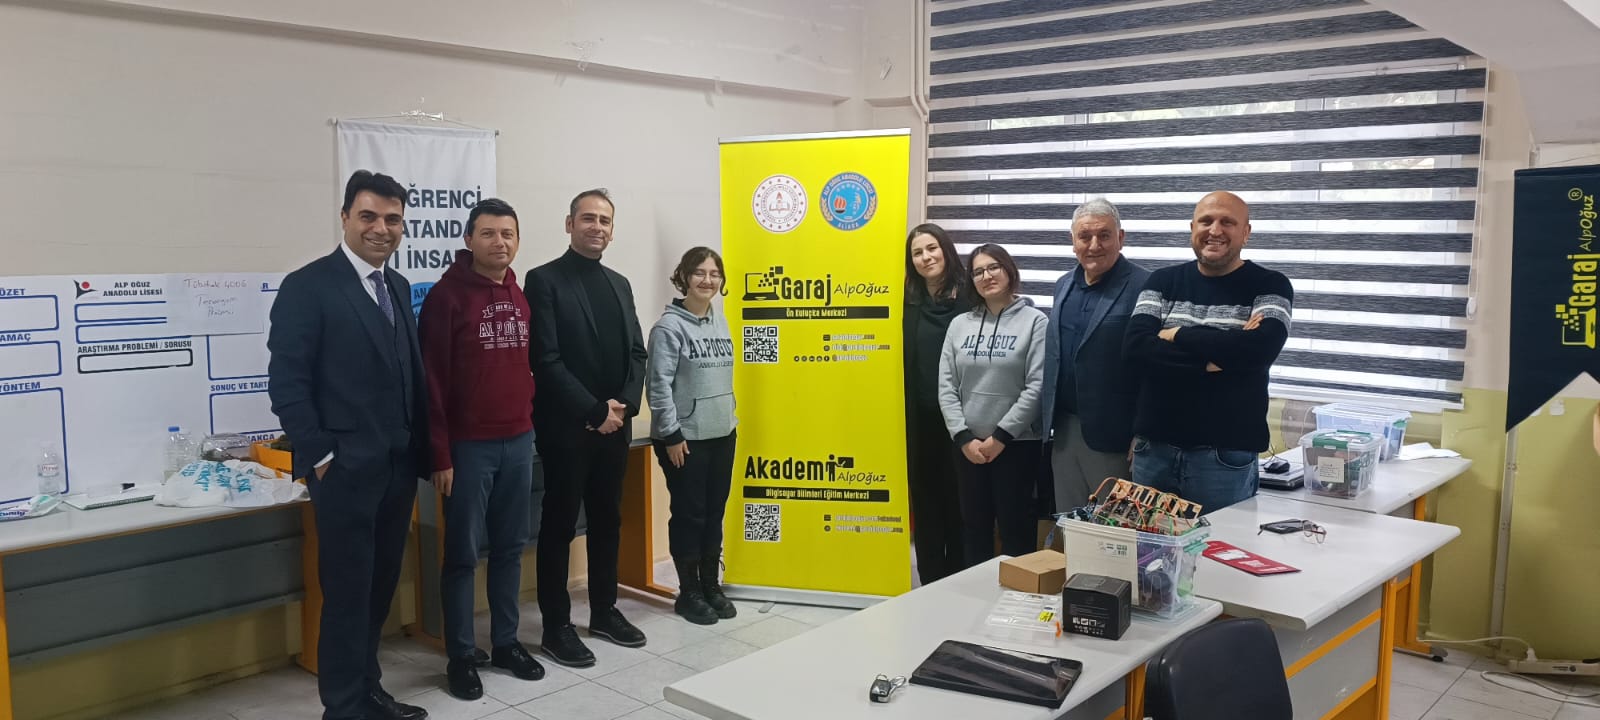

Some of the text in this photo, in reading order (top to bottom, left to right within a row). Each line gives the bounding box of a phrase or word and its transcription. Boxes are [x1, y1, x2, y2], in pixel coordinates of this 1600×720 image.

[406, 183, 482, 209] ĞRENCİ
[1578, 194, 1597, 251] AlpOğuz
[407, 245, 455, 269] İNSA
[103, 288, 162, 297] ANADOLU LİSESİ
[781, 274, 889, 306] Garaj AlpOğuz
[821, 308, 847, 317] Merkezi
[0, 333, 31, 342] AMAÇ
[960, 334, 985, 350] ALP
[78, 344, 120, 354] ARAŞTIRMA
[122, 340, 158, 351] PROBLEMİ
[165, 340, 192, 349] SORUSU
[210, 381, 268, 392] SONUÇ VE TART
[837, 471, 886, 486] AlpOğuz
[766, 488, 870, 500] Bilgisayar Bilimleri Eğitim Merkezi
